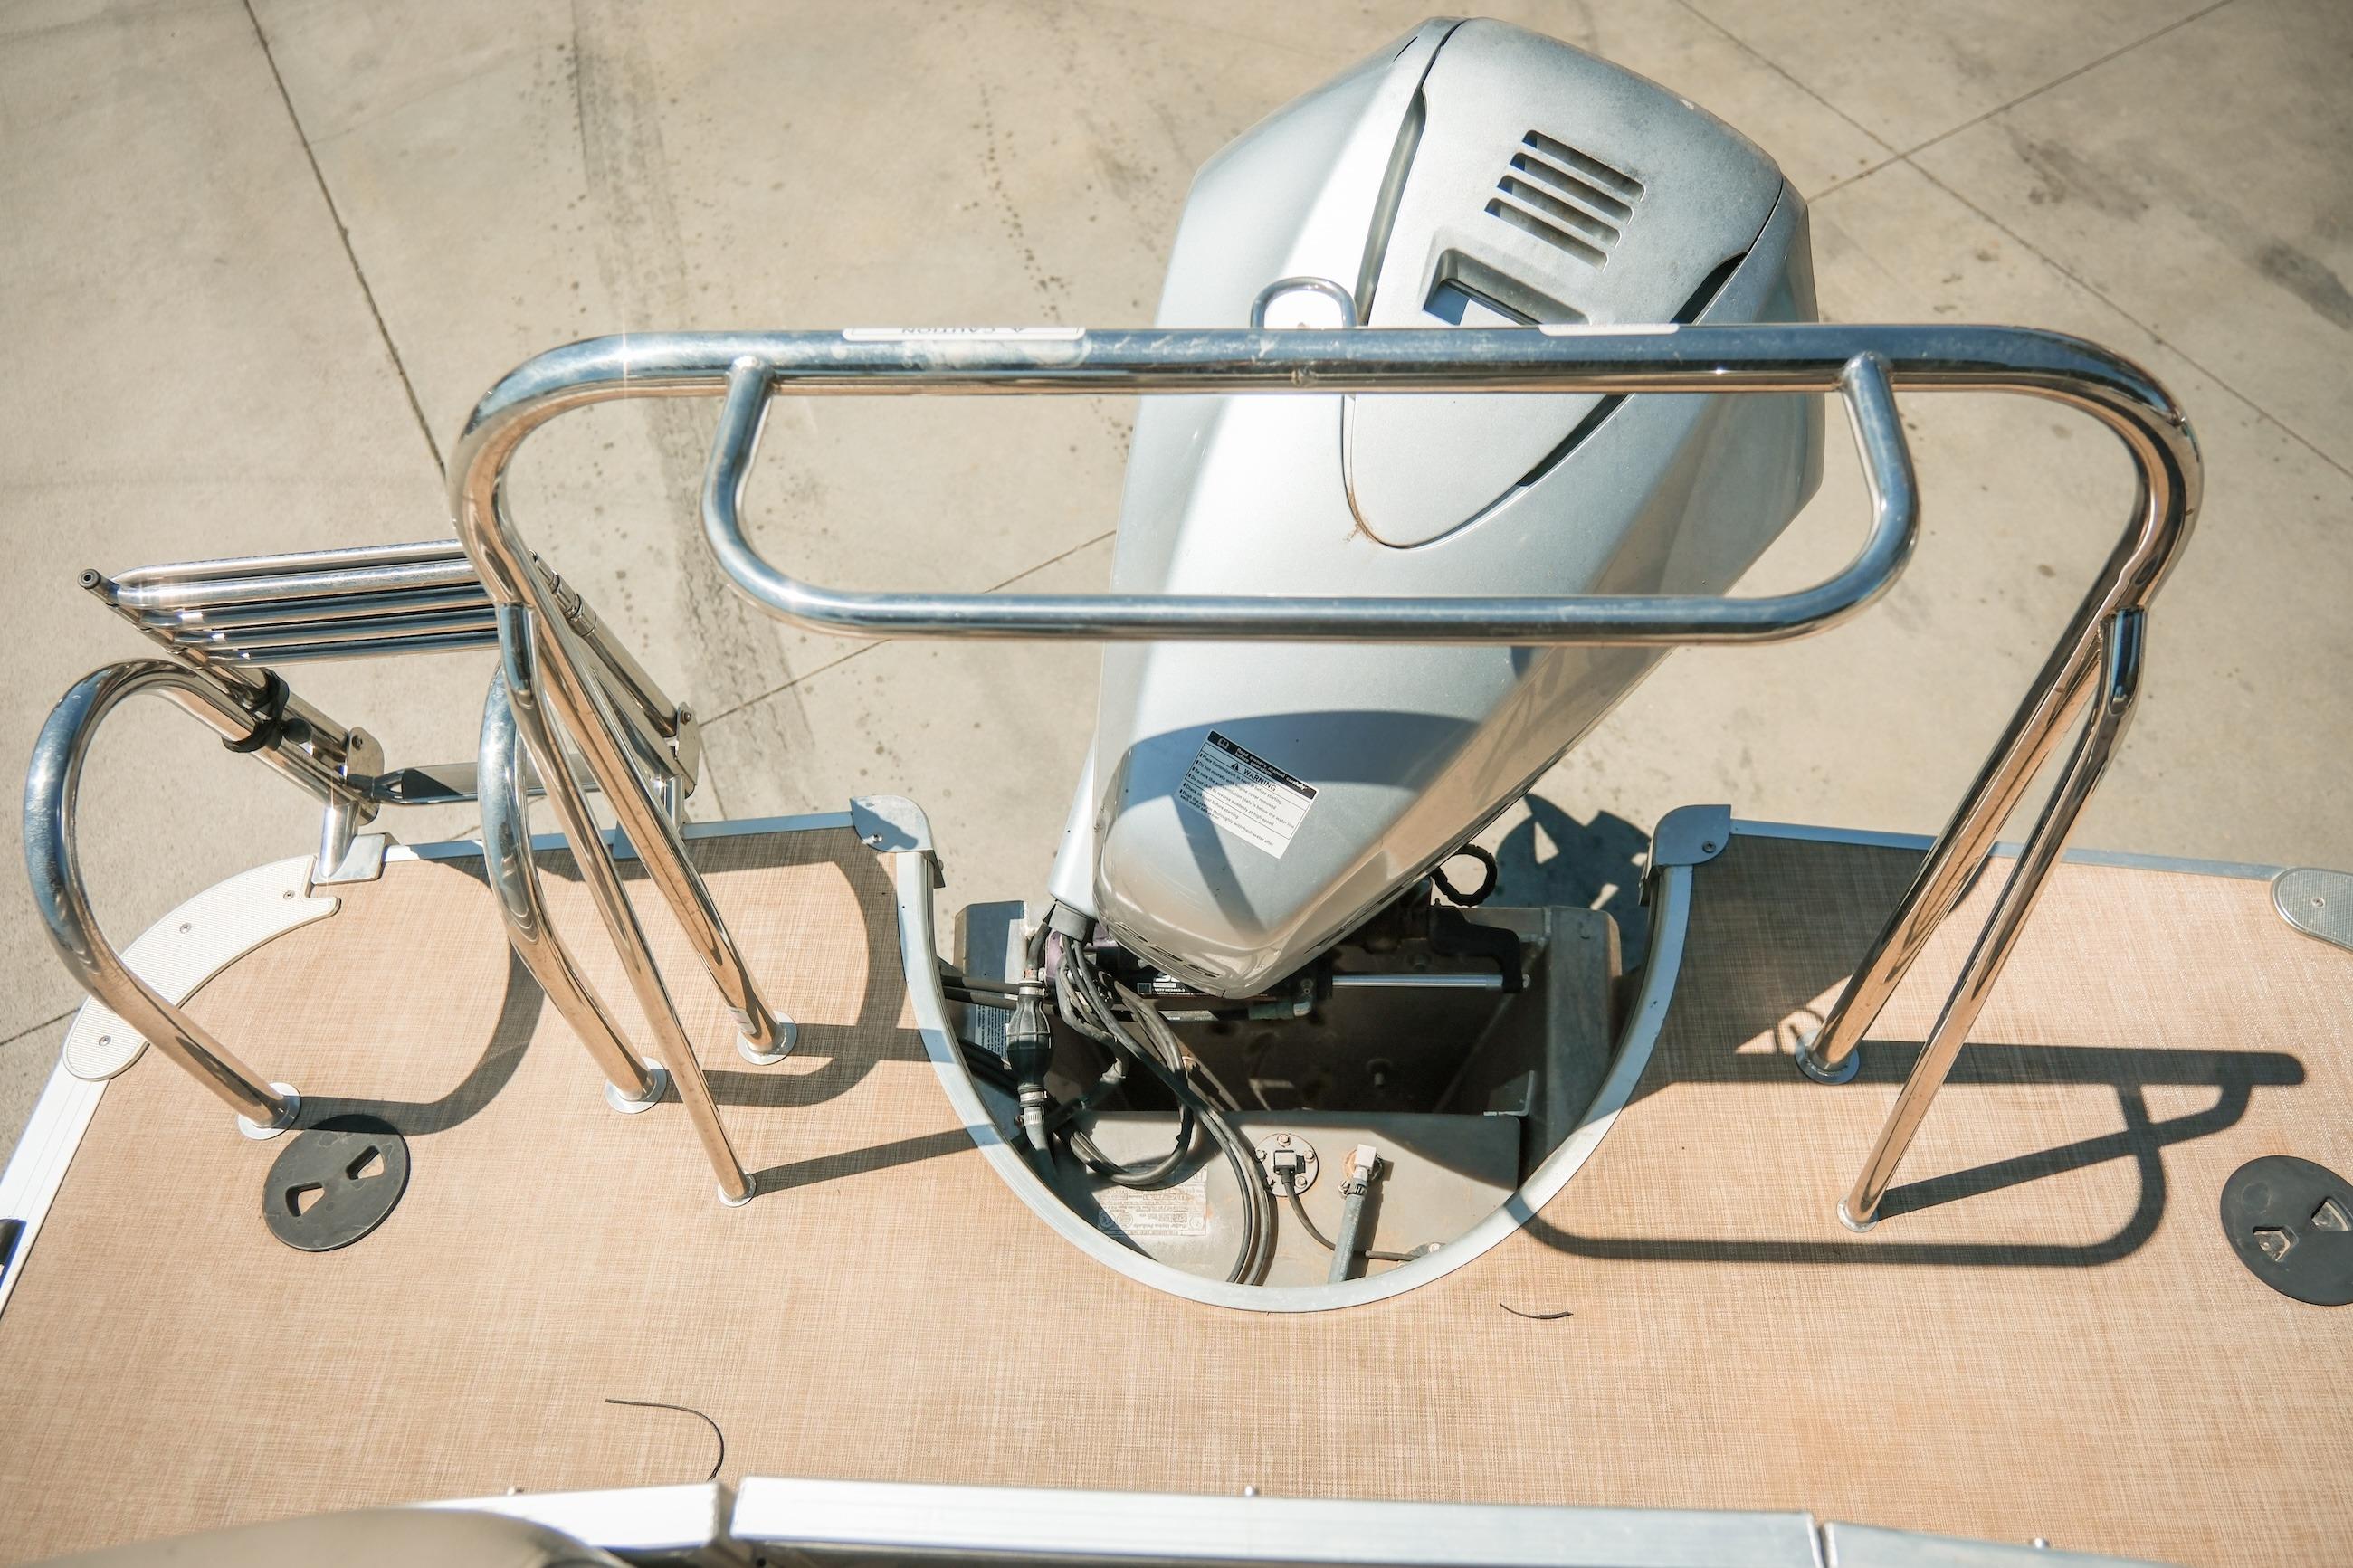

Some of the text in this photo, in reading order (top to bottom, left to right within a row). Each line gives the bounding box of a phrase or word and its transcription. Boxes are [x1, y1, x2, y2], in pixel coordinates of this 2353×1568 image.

[1234, 752, 1249, 764] before
[1243, 768, 1277, 792] WARNING
[1211, 769, 1226, 781] operate
[1258, 797, 1277, 811] removed
[1267, 793, 1282, 804] starting
[1224, 807, 1240, 819] starting
